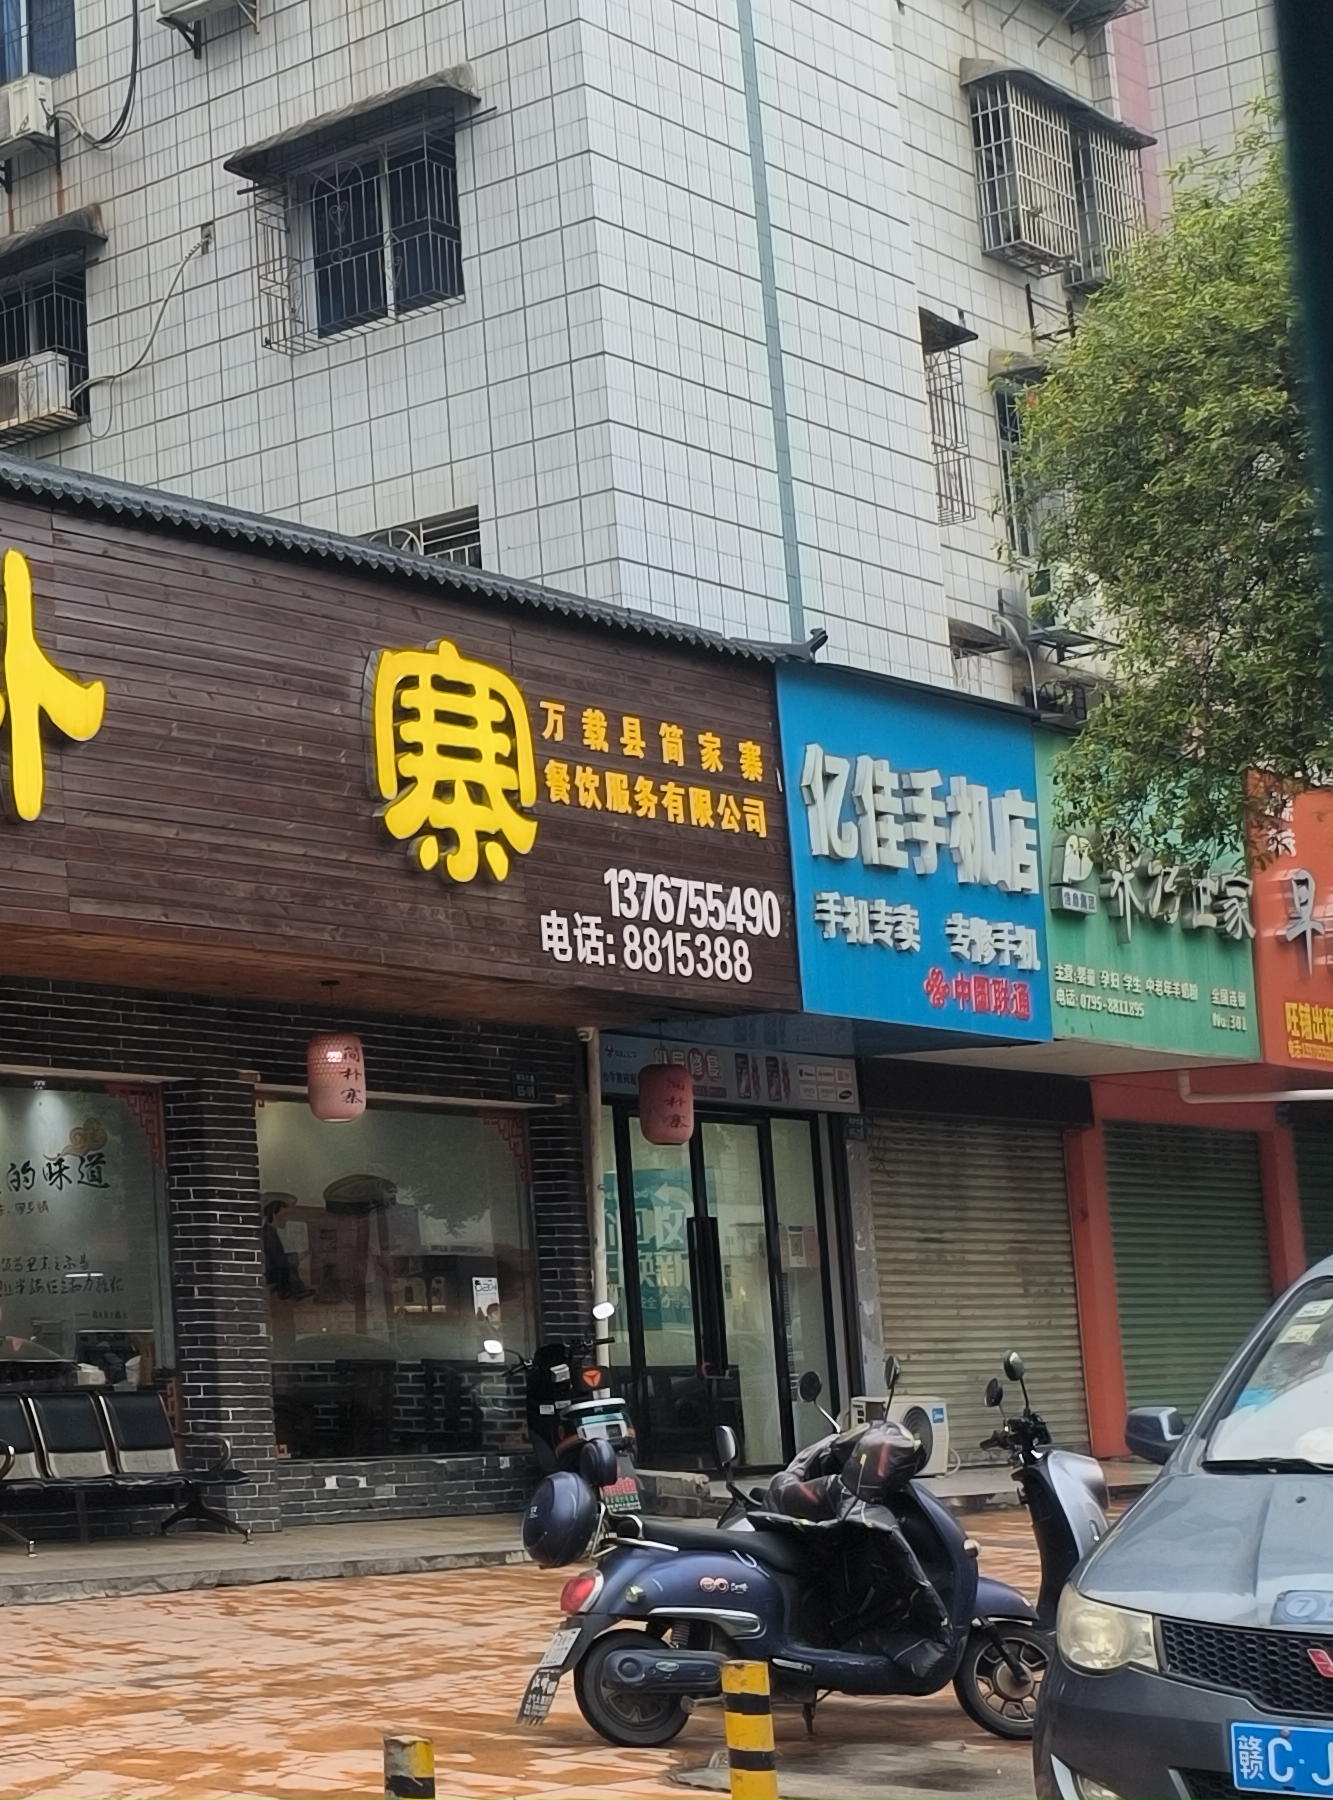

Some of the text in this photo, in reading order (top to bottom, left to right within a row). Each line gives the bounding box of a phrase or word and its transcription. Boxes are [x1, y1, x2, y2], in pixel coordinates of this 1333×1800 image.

[539, 701, 763, 782] 万载县简家寨
[544, 759, 767, 838] 餐饮服务有限公司
[801, 743, 1039, 894] 亿佳手机店
[603, 868, 781, 938] 1376755490
[814, 891, 1041, 970] 手机专卖 专修手机
[952, 972, 1031, 1021] 中国联通
[1122, 974, 1142, 994] 学生
